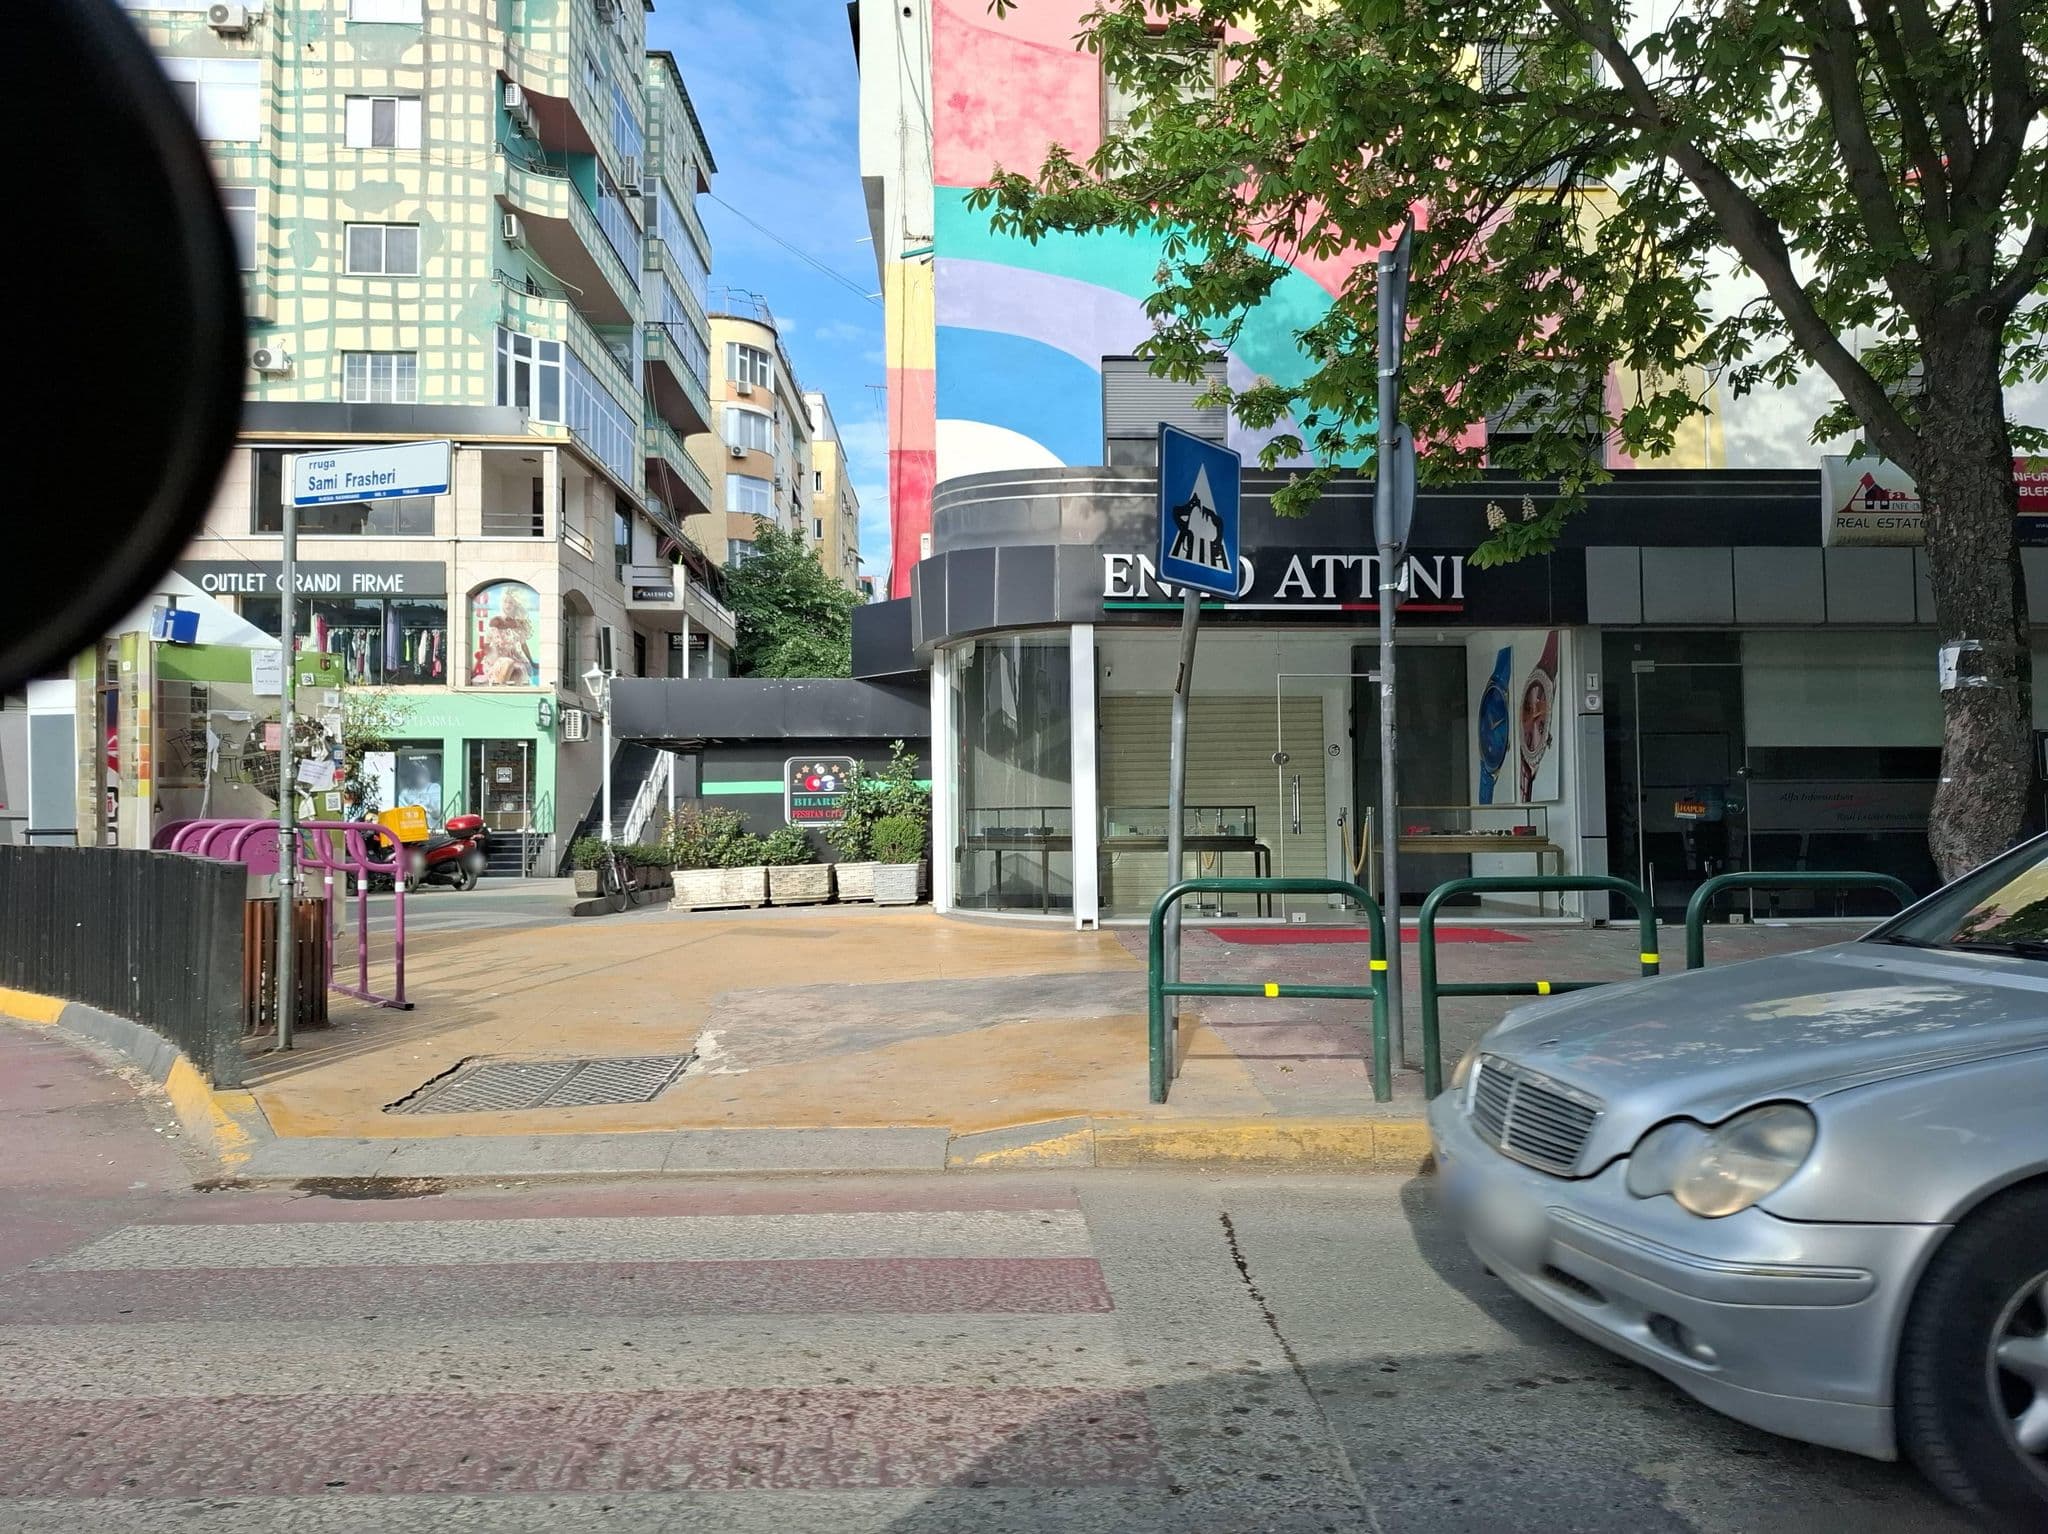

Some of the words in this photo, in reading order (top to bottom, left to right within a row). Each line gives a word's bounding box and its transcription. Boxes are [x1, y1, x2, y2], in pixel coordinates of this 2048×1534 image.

[308, 459, 335, 471] rruga
[308, 474, 338, 491] Sami
[345, 468, 396, 488] Frasheri
[1836, 517, 1870, 529] REAL
[201, 573, 268, 592] OUTLET
[352, 573, 404, 592] FIRME
[1274, 553, 1465, 599] ATTNI
